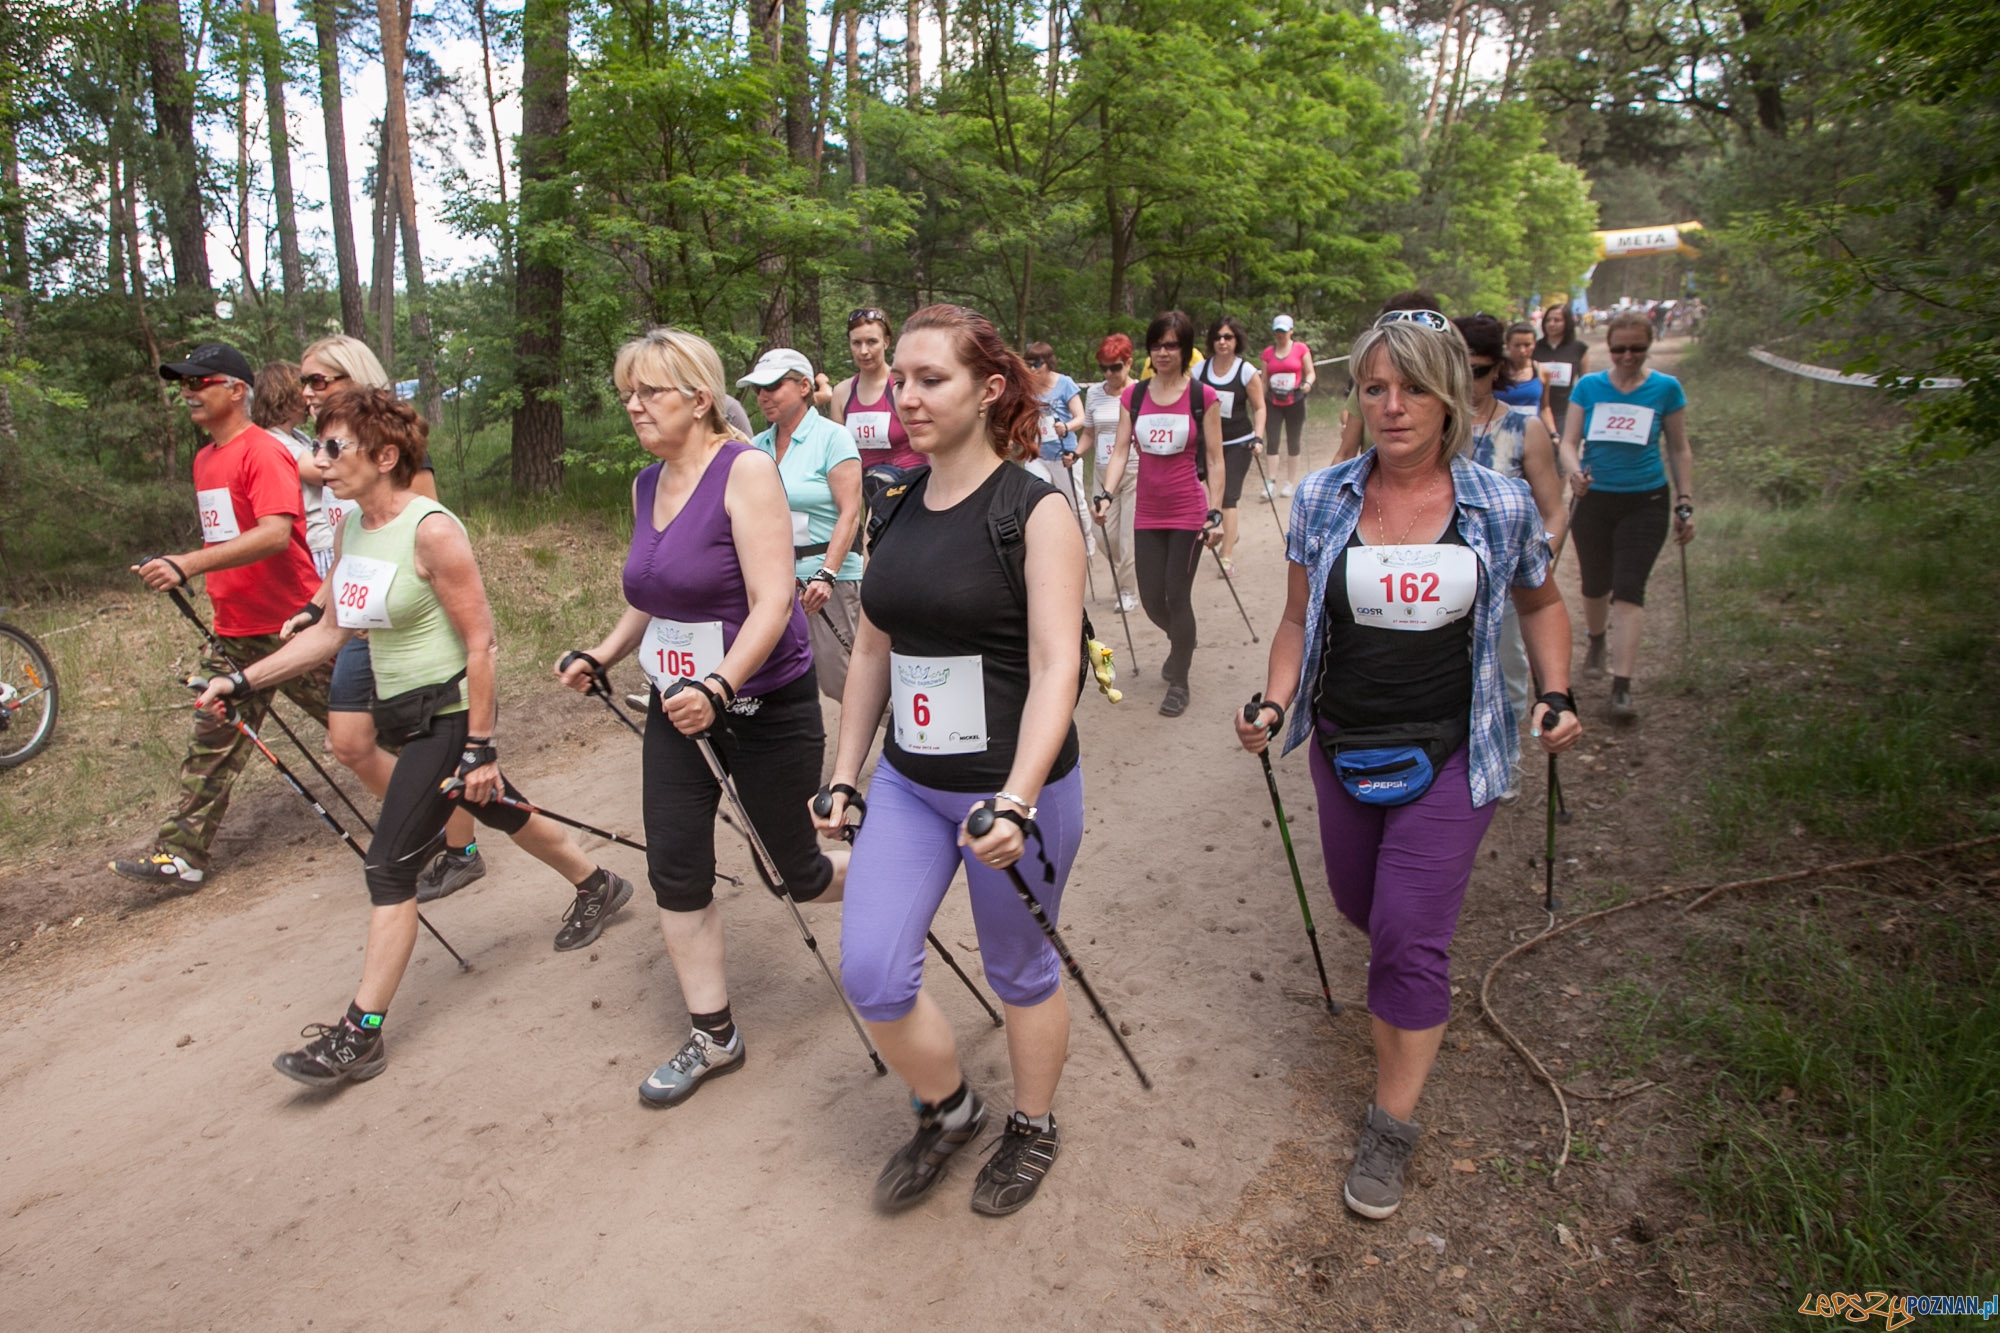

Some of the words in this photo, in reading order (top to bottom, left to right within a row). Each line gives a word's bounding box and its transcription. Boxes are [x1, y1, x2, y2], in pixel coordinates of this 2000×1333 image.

[1618, 233, 1667, 247] META
[857, 425, 876, 438] 191
[1606, 416, 1636, 431] 222
[1149, 429, 1174, 444] 221
[339, 582, 369, 610] 288
[1379, 572, 1440, 603] 162
[656, 648, 696, 677] 105
[913, 693, 931, 727] 6
